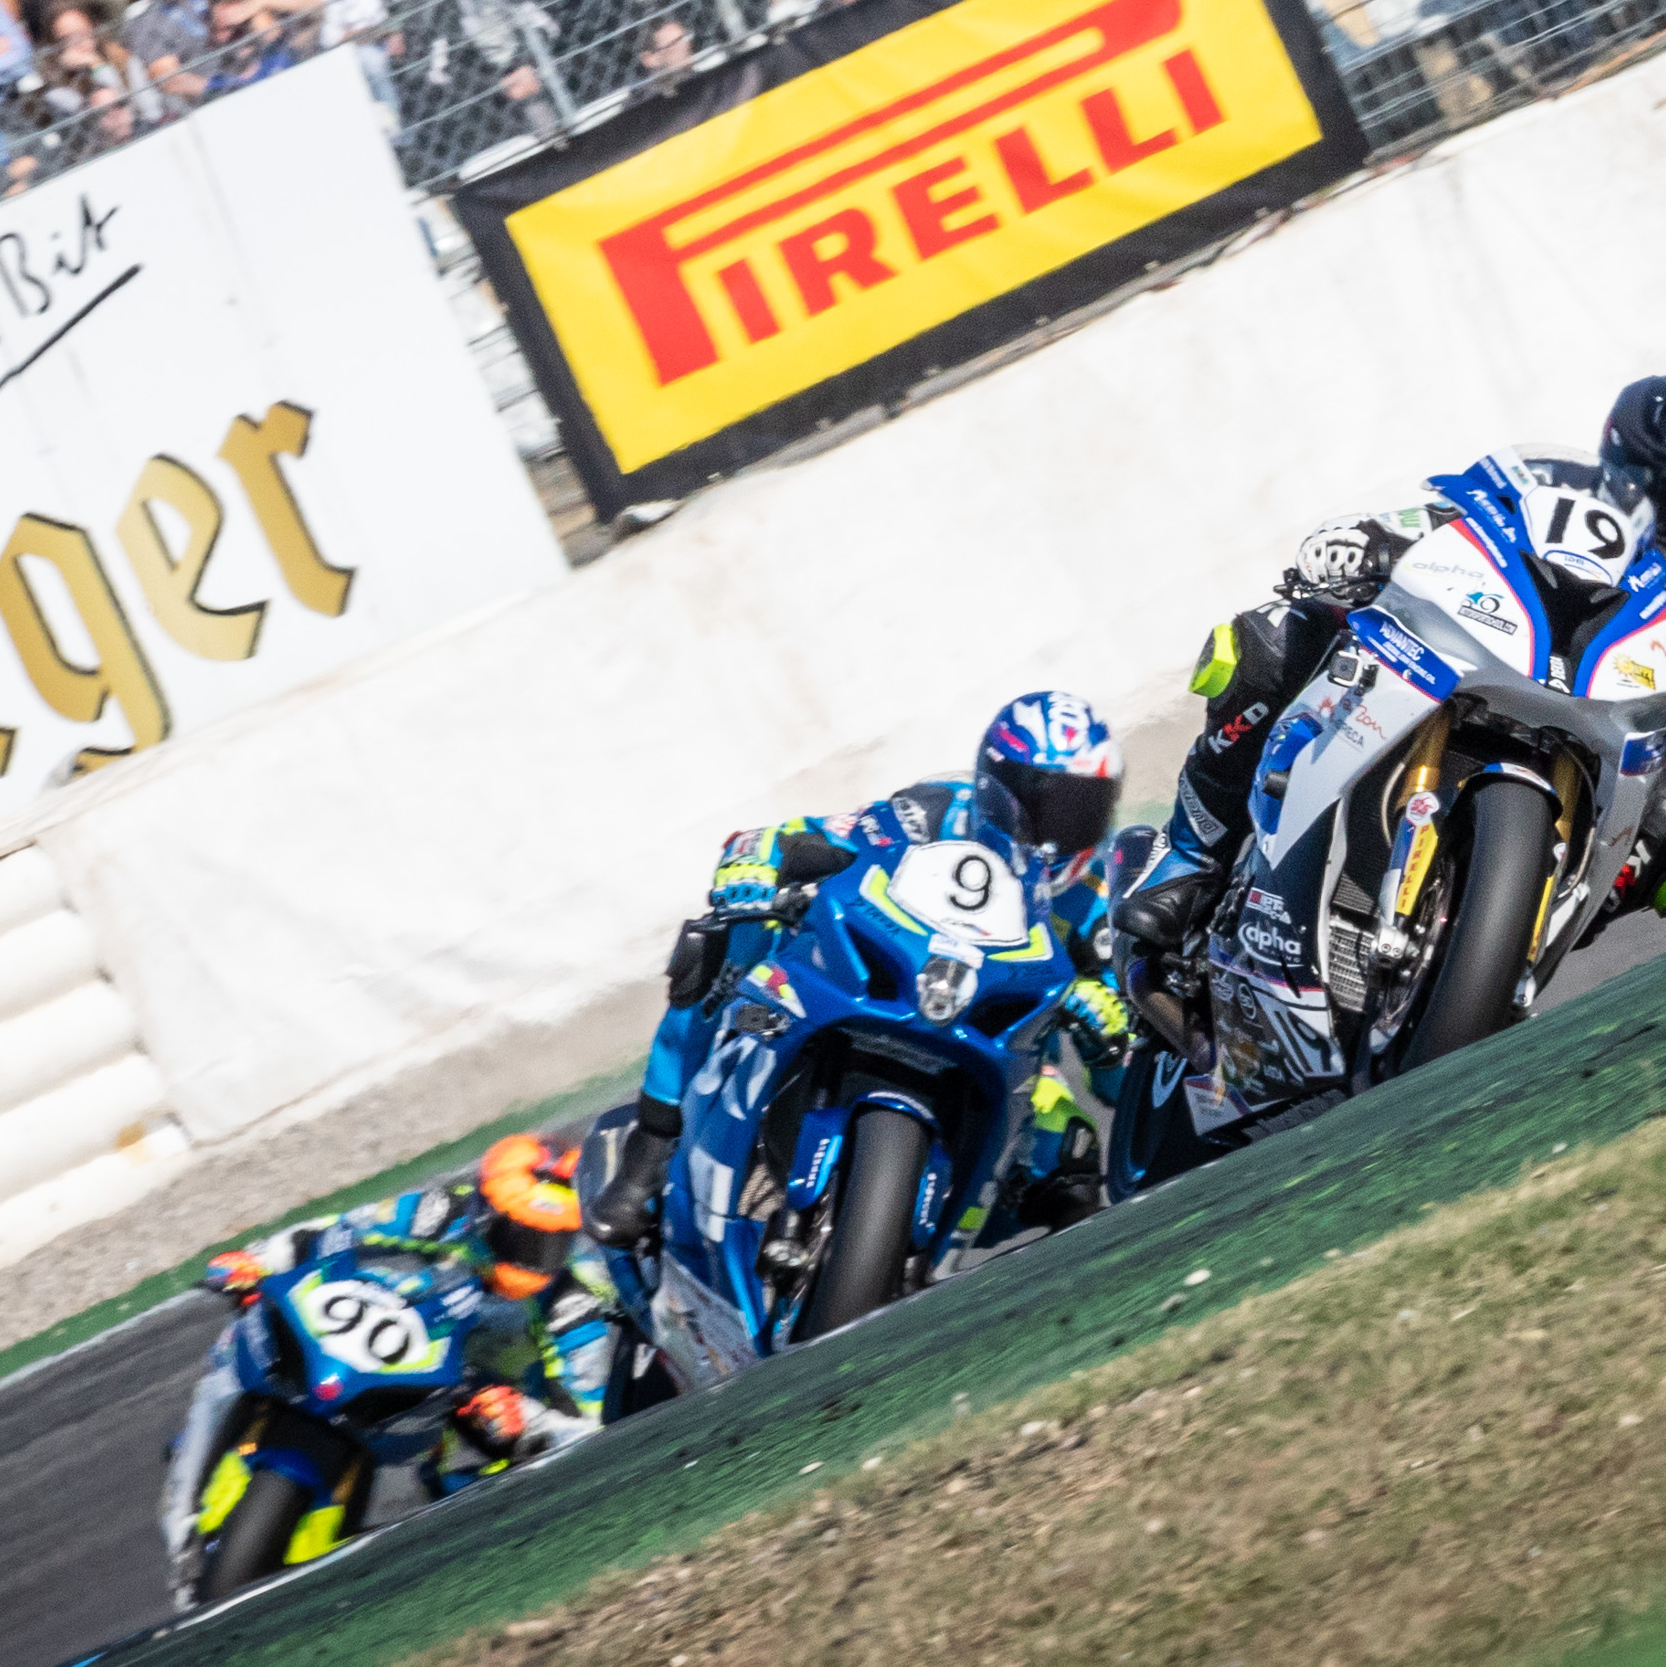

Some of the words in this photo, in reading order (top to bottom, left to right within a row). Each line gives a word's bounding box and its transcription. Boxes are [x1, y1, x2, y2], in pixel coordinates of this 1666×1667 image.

[1545, 497, 1625, 560] 19
[1412, 561, 1485, 579] alpha
[949, 855, 992, 912] 9
[1400, 824, 1430, 909] PIRELLI
[320, 1294, 412, 1366] 90
